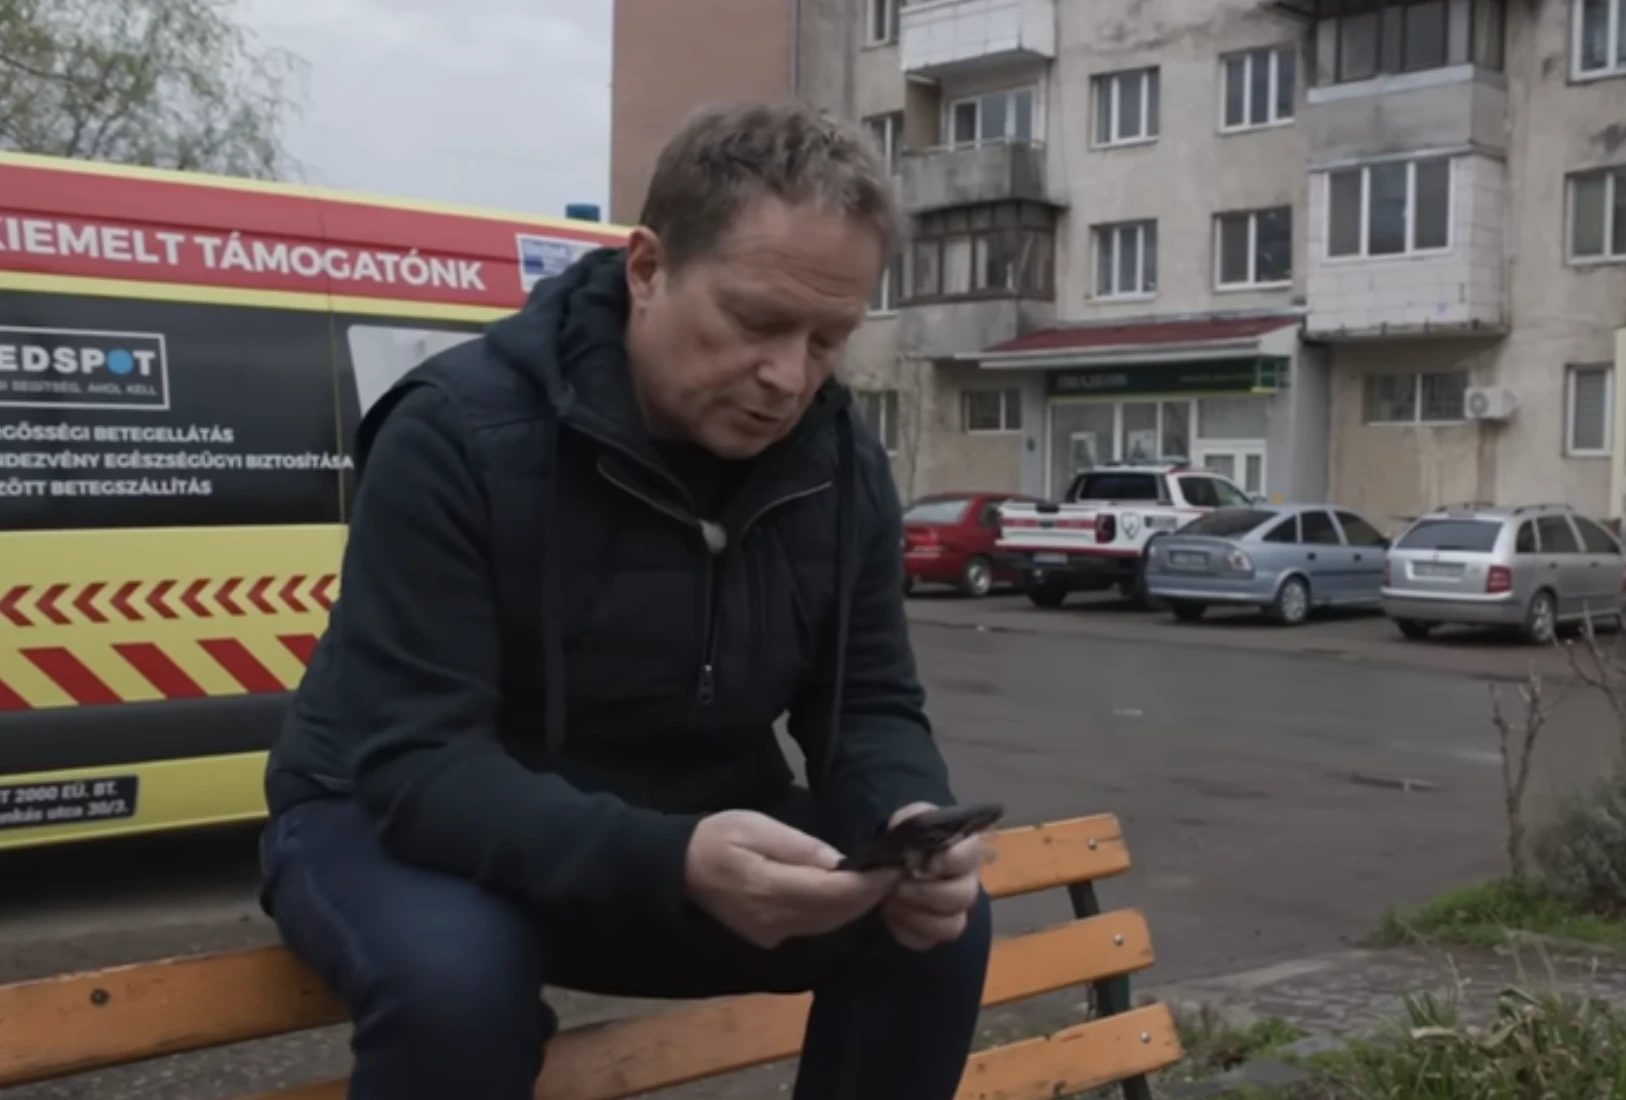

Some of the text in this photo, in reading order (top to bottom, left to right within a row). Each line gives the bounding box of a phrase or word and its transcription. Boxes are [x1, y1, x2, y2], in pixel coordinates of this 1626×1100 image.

[0, 217, 185, 265] IEMELT
[193, 231, 486, 291] TÁMOGATÓNK
[0, 421, 235, 443] GŐSSÉGI BETEGELLÁTÁS
[246, 452, 354, 470] BIZTOSÍTÁSA
[51, 477, 212, 497] BETEGSZÁLLÍTÁS
